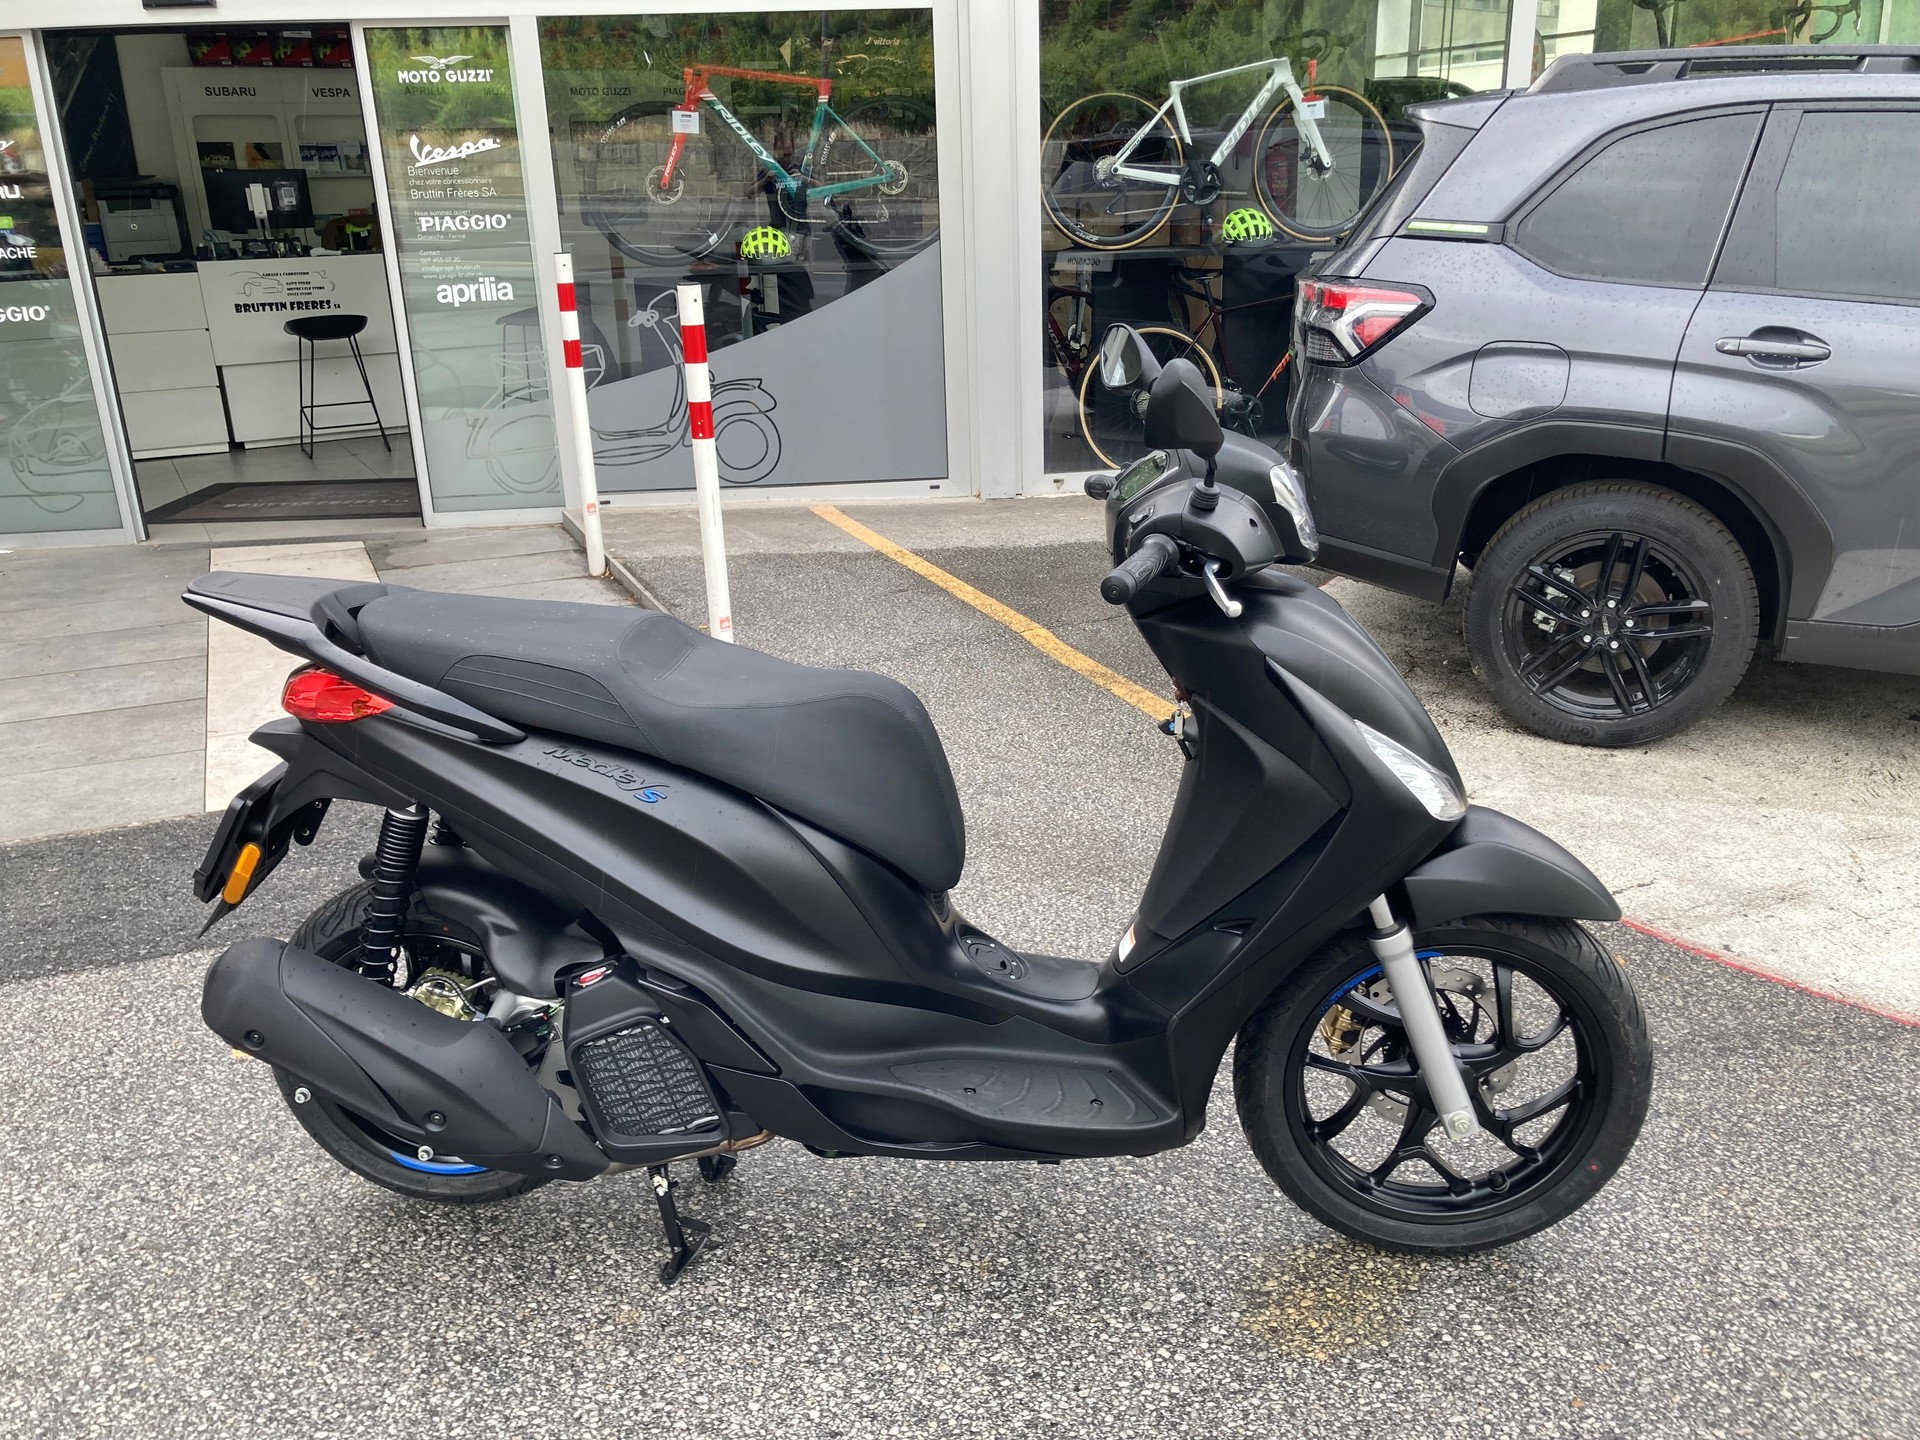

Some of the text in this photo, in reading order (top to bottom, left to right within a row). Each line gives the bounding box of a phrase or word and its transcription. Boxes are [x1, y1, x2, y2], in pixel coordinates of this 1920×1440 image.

[398, 69, 491, 83] MOTO GUZZI
[205, 86, 257, 97] SUBARU
[312, 88, 351, 98] VESPA
[404, 86, 448, 96] APRILIA
[570, 87, 632, 96] MOTO GUZZI
[1219, 78, 1277, 160] RIDLEY
[713, 104, 776, 163] RIDLEY
[410, 134, 501, 167] Vespa
[664, 142, 679, 178] RIDLEY
[407, 165, 460, 177] Bienvenue
[443, 177, 493, 185] concessionnaire
[410, 186, 497, 200] Bruttin Frères SA
[419, 214, 508, 232] PIAGGIO
[436, 277, 514, 307] aprilia
[234, 301, 287, 313] BRUTTIN
[289, 300, 331, 311] FRERES
[543, 744, 670, 804] Medley S
